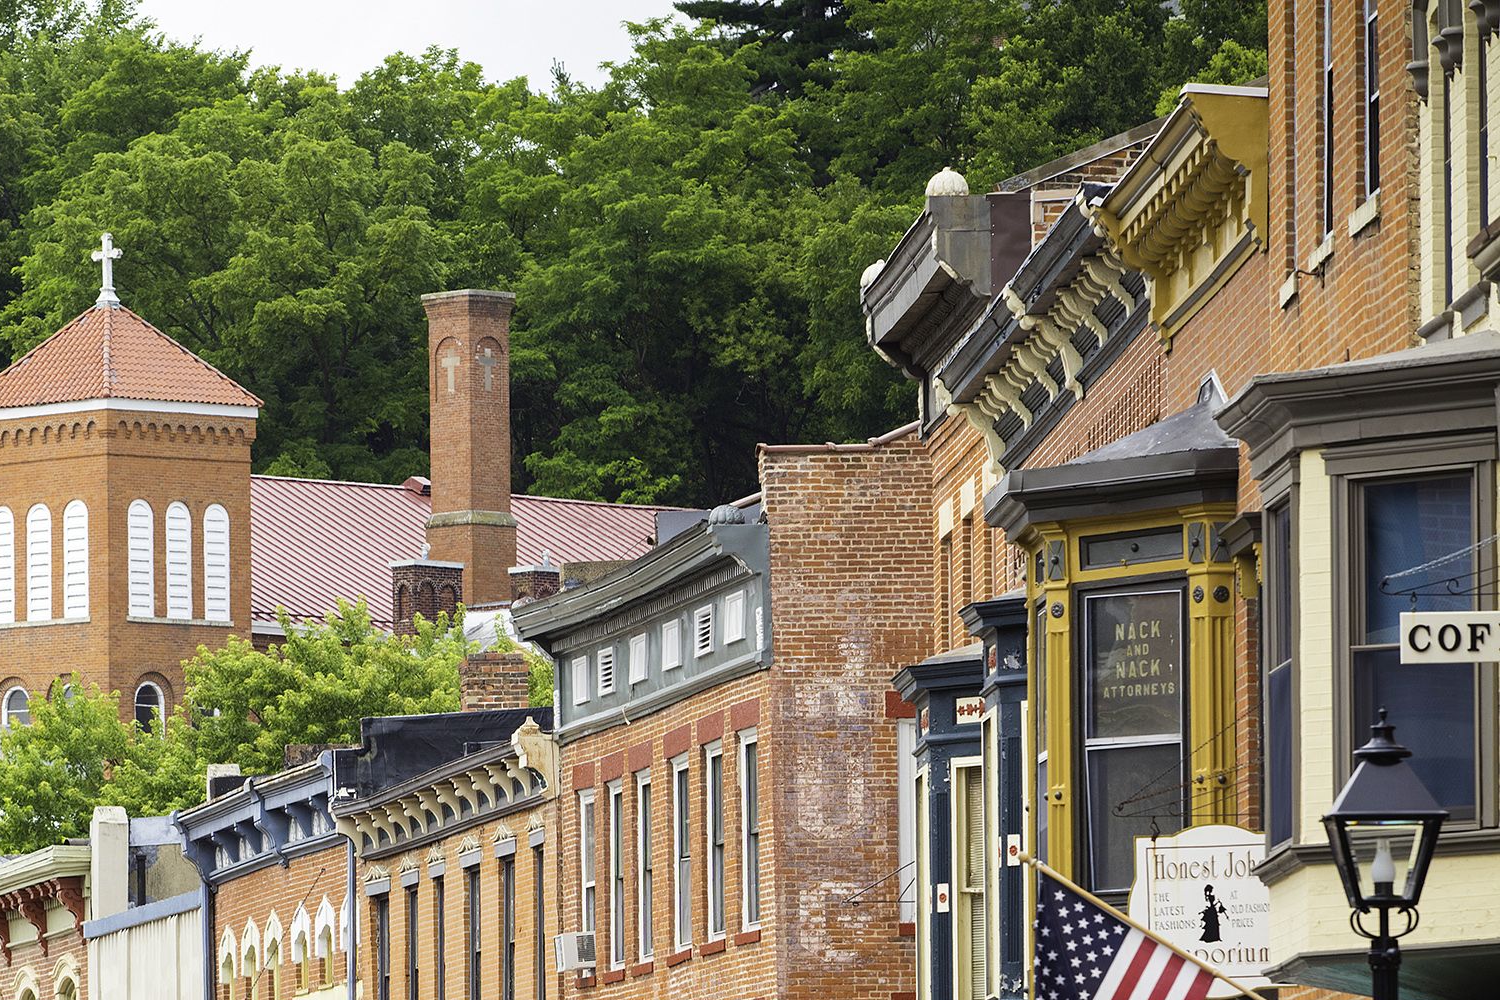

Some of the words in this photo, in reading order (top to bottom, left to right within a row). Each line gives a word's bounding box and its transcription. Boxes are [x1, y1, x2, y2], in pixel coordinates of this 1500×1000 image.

[1115, 620, 1160, 640] NACK
[1408, 623, 1500, 652] COF
[1126, 643, 1150, 656] AND
[1116, 659, 1160, 679] NACK
[1103, 682, 1175, 698] ATTORNEYS
[1154, 854, 1218, 880] Honest
[1224, 850, 1264, 879] Joh
[1154, 892, 1170, 903] THE
[1153, 905, 1185, 917] LATEST
[1154, 919, 1197, 931] FASHIONS
